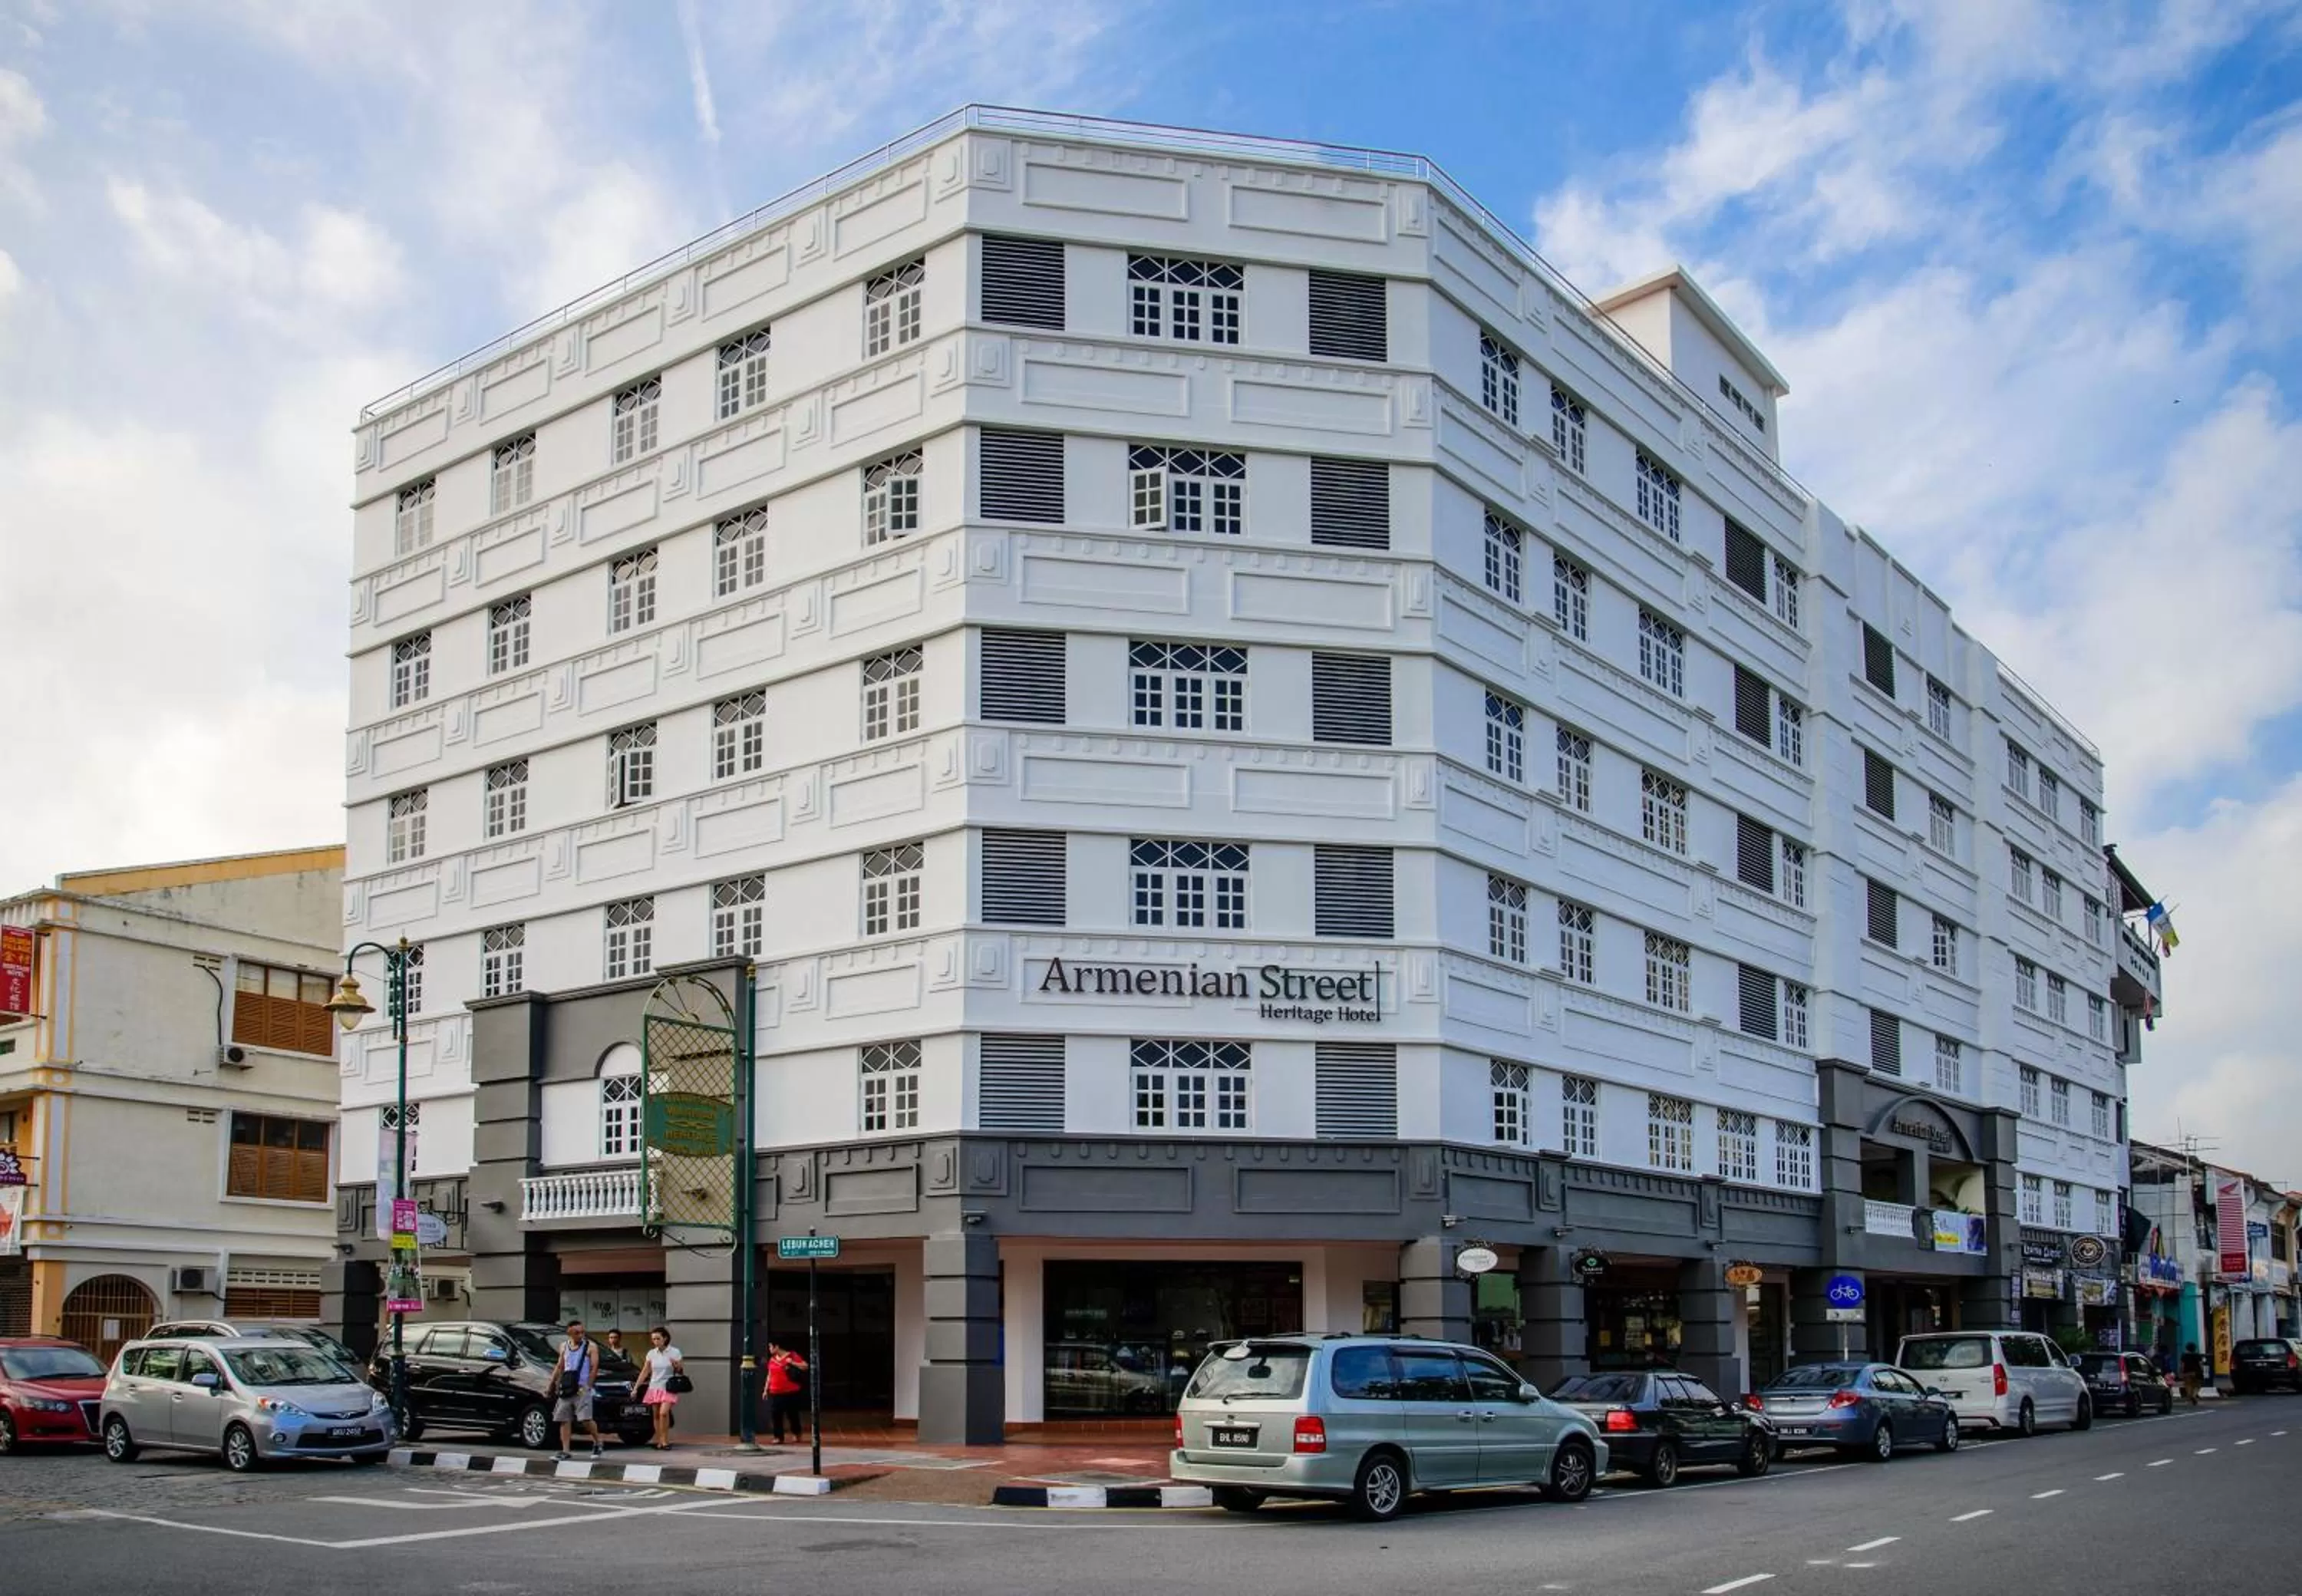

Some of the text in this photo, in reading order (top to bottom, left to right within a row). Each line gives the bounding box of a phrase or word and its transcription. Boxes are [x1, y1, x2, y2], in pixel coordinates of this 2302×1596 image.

[1039, 957, 1373, 1001] Armenian Street
[1260, 1004, 1333, 1024] Heritage
[782, 1239, 808, 1249] LEBUH
